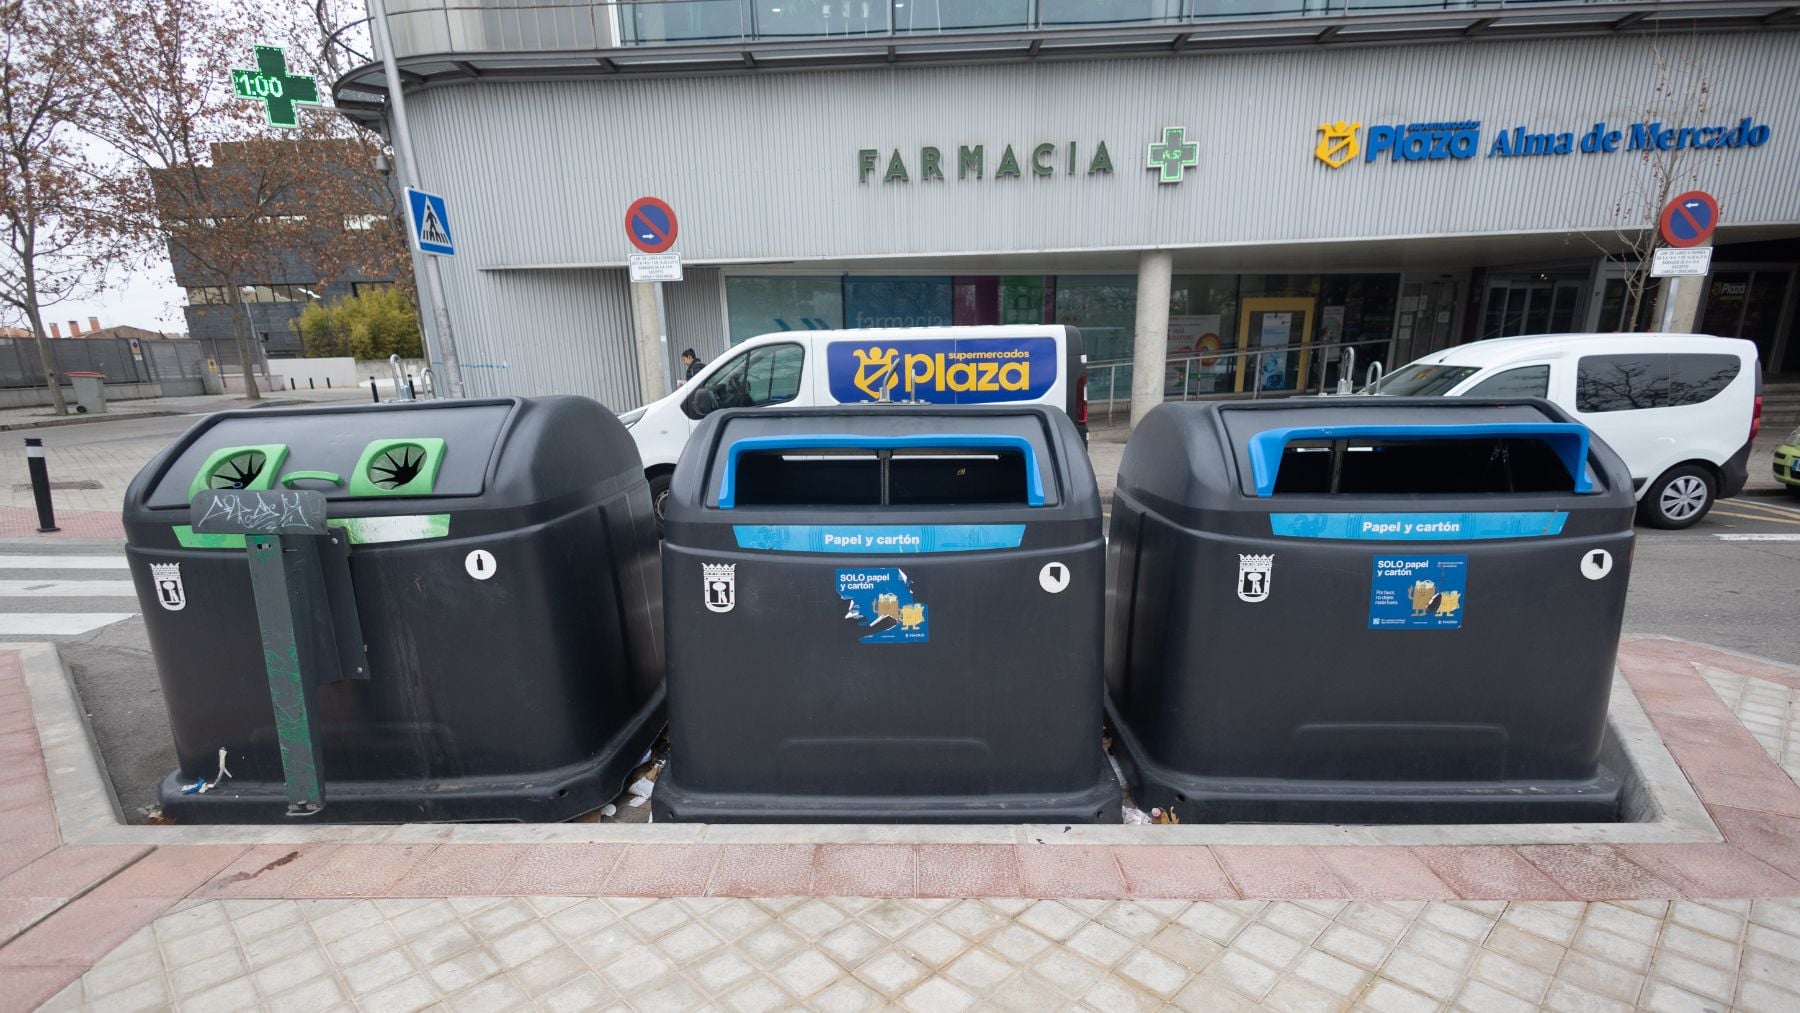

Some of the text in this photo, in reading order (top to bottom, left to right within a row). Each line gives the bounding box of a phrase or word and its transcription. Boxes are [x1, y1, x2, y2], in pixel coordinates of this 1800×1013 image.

[1365, 117, 1771, 163] Plaza Alma de Mercado
[858, 140, 1114, 183] FARMACIA
[855, 310, 944, 328] farmacia
[948, 349, 1030, 361] supermercados
[1362, 521, 1460, 534] Papel y cartón
[824, 533, 920, 546] Papel y cartón
[1377, 560, 1404, 568] SOLO
[1405, 560, 1429, 570] papel
[840, 573, 890, 583] SOLO papel
[1384, 568, 1412, 576] cartón
[840, 582, 874, 592] y cartón
